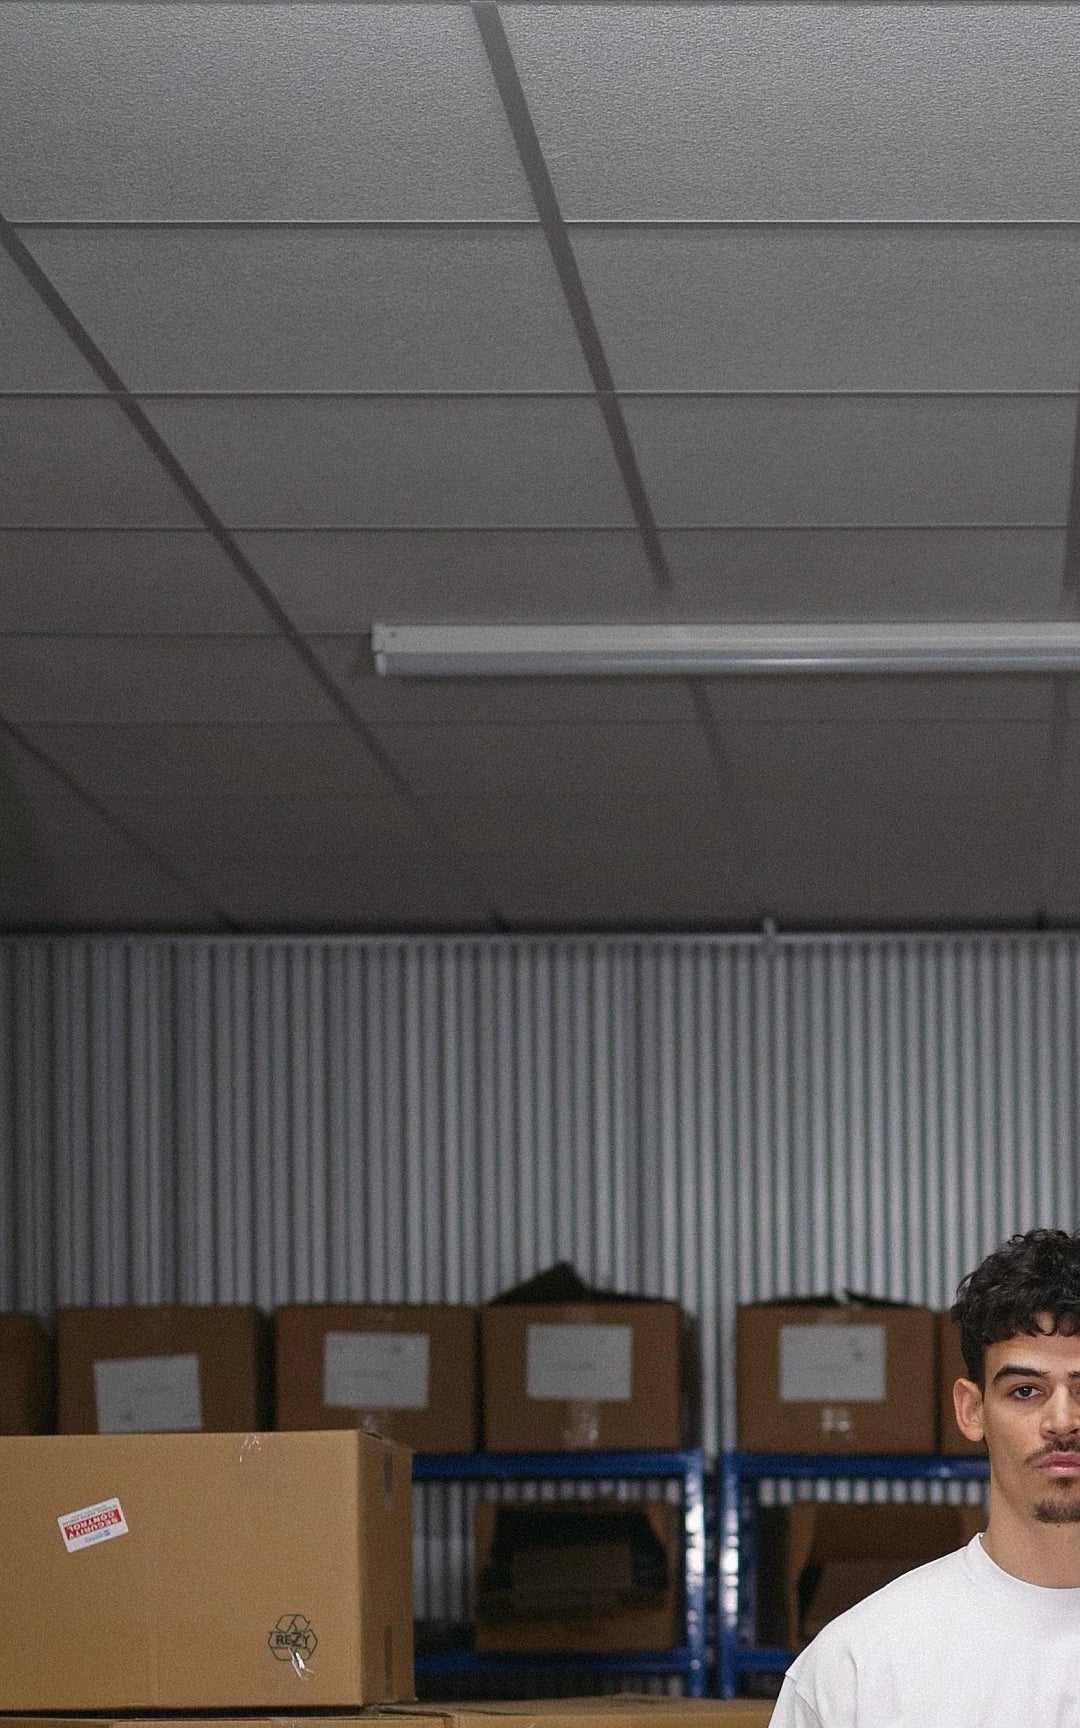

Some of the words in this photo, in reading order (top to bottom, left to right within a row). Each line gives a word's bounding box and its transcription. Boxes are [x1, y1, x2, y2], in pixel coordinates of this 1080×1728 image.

[67, 1511, 115, 1532] CONTROL
[69, 1516, 118, 1540] SECURITY
[276, 1631, 310, 1648] REZY
